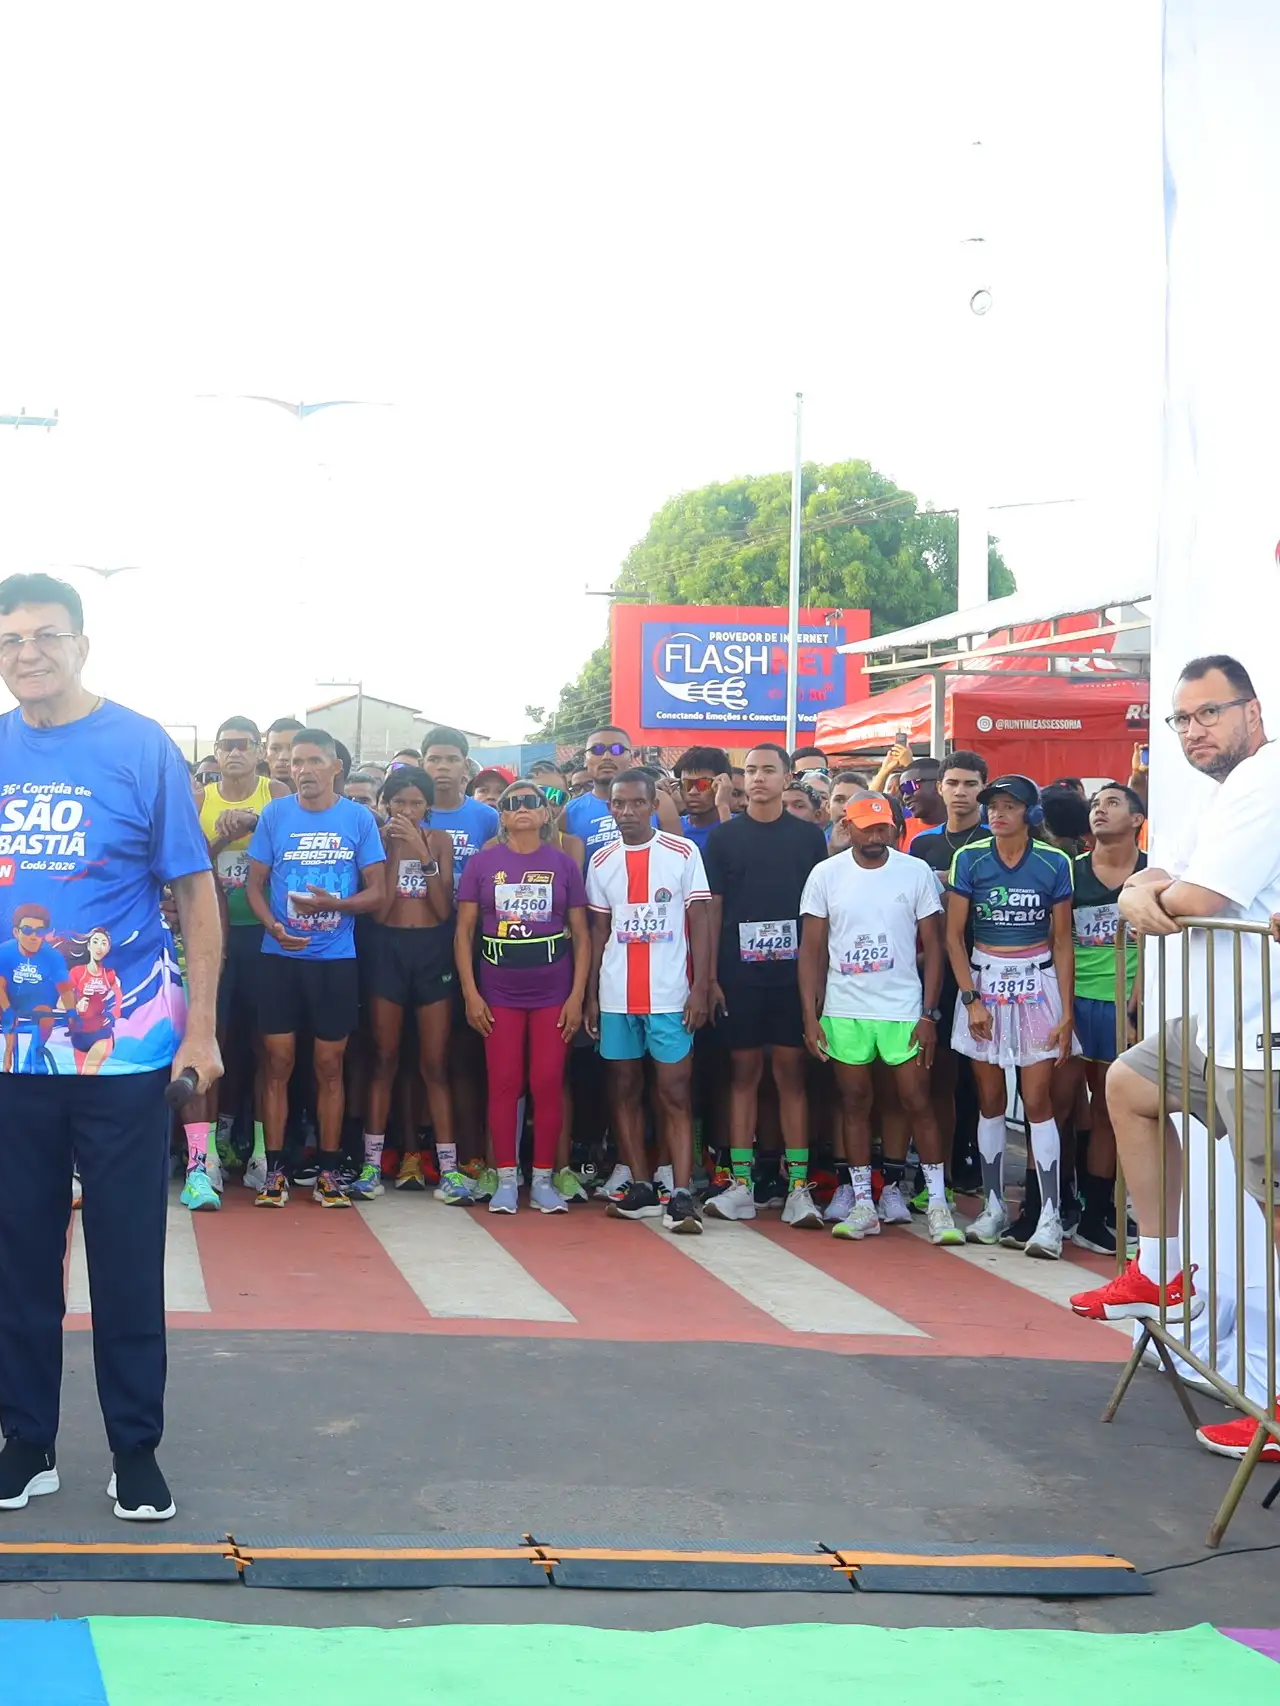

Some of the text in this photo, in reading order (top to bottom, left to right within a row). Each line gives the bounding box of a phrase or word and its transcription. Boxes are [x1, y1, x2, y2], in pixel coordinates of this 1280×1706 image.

[709, 631, 829, 644] PROVEDOR DE INERNET
[656, 711, 704, 721] Conectando
[706, 712, 740, 723] Emoções
[742, 714, 748, 722] e
[749, 713, 790, 723] Conectan
[996, 719, 1082, 730] @RUNTIMEASSESSORIA
[22, 781, 72, 796] Corrida
[74, 786, 92, 797] de
[0, 794, 83, 832] SÃO
[283, 847, 354, 860] SEBASTIÃO
[20, 859, 76, 871] Codó 2026
[503, 899, 547, 911] 14560
[748, 936, 792, 950] 14428
[845, 946, 889, 963] 14262
[989, 979, 1036, 993] 13815
